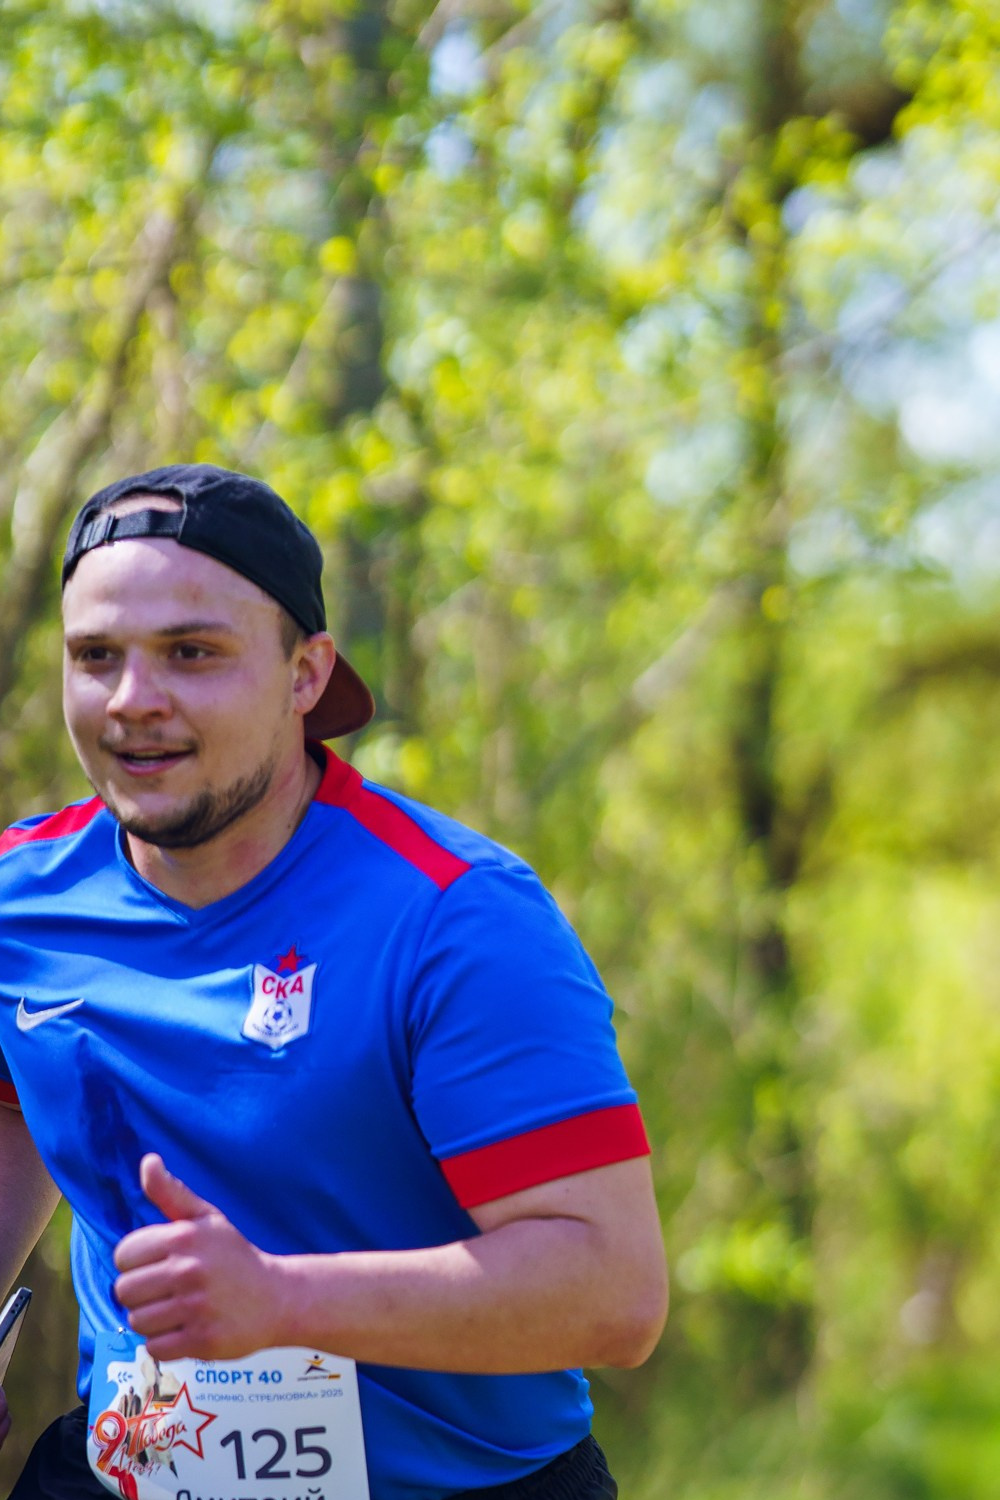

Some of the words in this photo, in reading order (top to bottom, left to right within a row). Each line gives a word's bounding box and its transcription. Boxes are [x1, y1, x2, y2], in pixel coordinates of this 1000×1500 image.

[262, 975, 304, 999] СКА
[195, 1369, 254, 1384] СПОРТ
[258, 1370, 283, 1384] 40
[321, 1388, 343, 1398] 2025
[220, 1426, 332, 1481] 125
